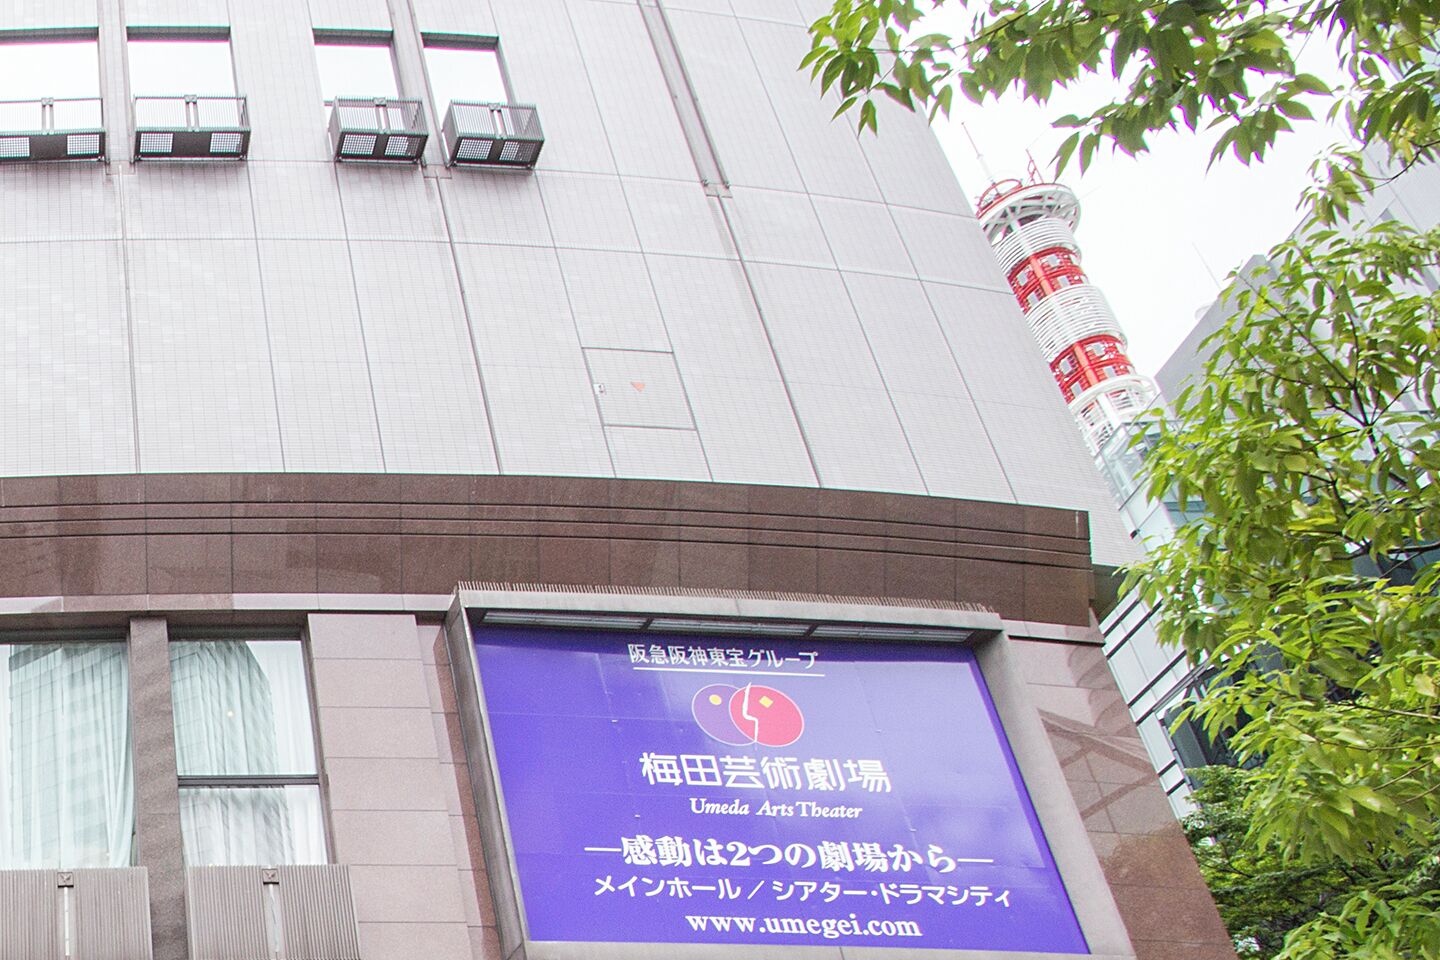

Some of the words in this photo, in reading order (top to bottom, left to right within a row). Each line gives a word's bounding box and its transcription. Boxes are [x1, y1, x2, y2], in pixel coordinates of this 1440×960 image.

[627, 642, 820, 671] 阪急阪神東宝グループ
[639, 751, 892, 793] 梅田芸術劇場
[689, 797, 751, 816] Umeda
[755, 800, 794, 818] Arts
[795, 801, 863, 819] Theater
[685, 911, 923, 938] www.umegei.com
